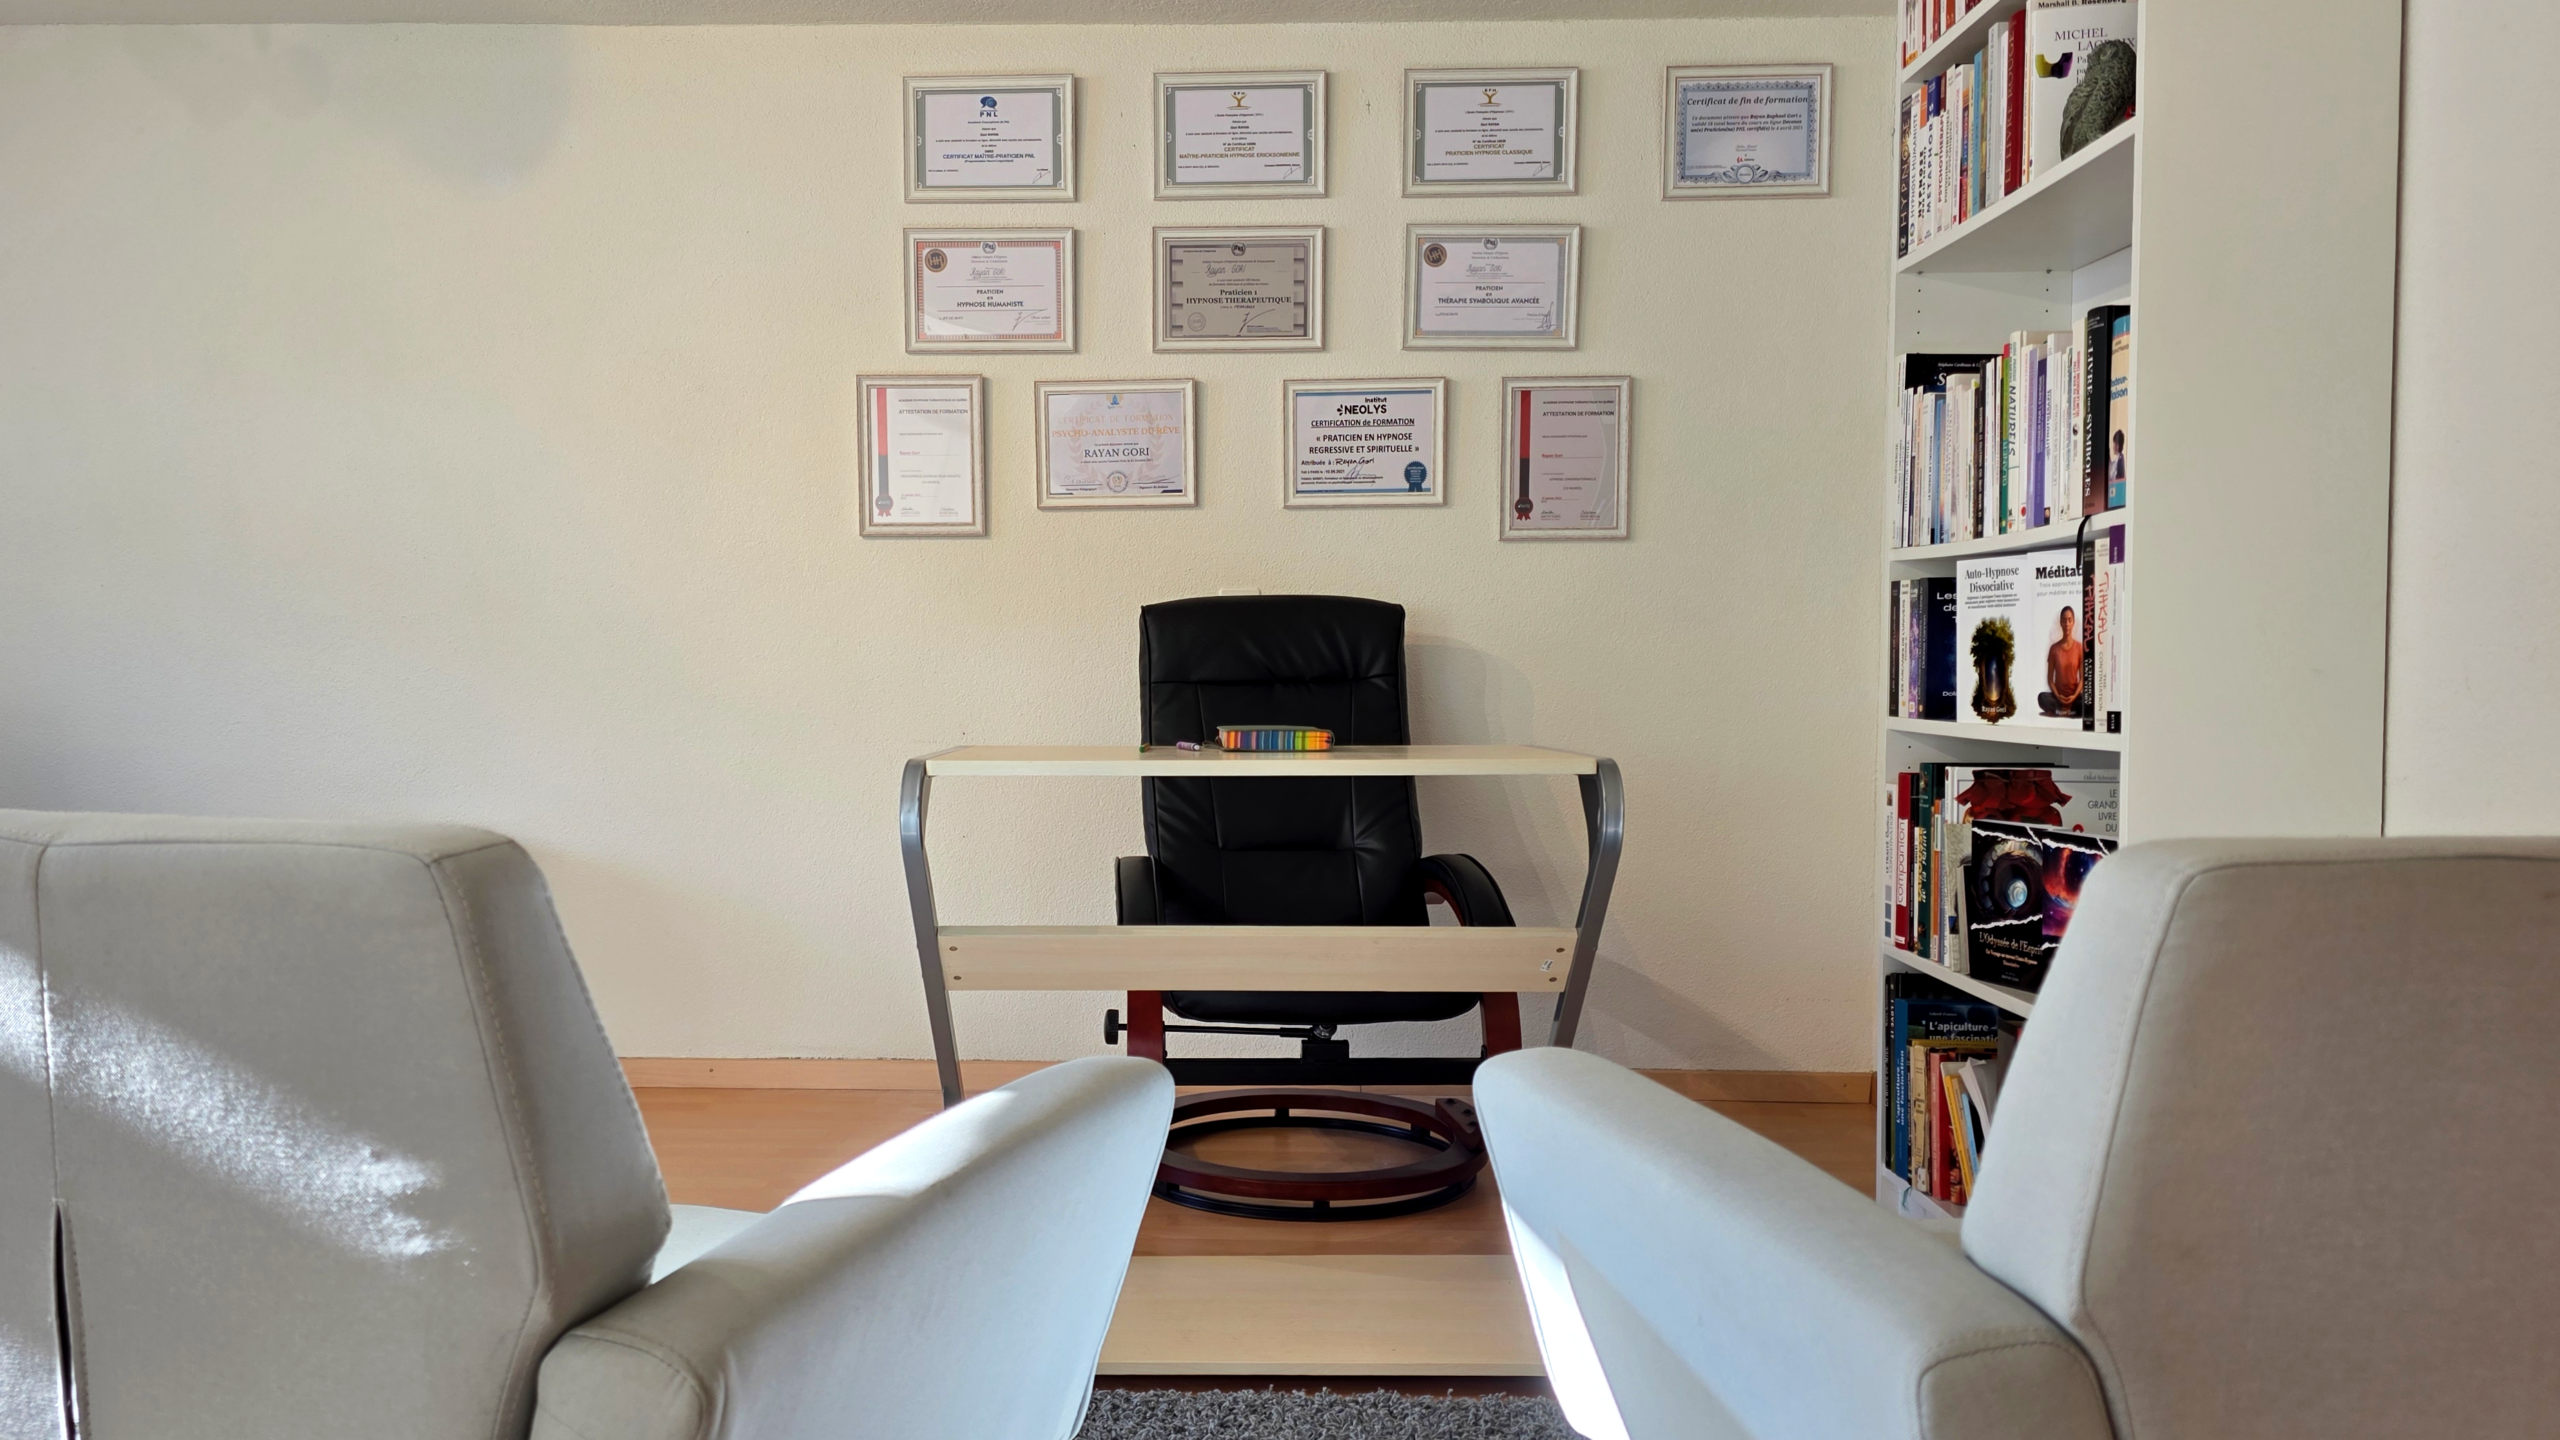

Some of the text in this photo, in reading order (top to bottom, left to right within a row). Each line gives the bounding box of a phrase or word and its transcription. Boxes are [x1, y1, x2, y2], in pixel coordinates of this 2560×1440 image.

[2038, 0, 2070, 9] Marshall
[2054, 28, 2108, 41] MICHEL
[1687, 95, 1808, 107] Certificat de fin de formation
[2005, 31, 2014, 184] LE LIVRE ROUGE
[1900, 119, 1910, 228] HYPNOSE
[1438, 296, 1468, 304] THÉRAPIE
[1511, 296, 1540, 304] AVANCÉE
[1344, 404, 1387, 415] NEOLYS
[1311, 419, 1361, 427] CERTIFICATION
[1372, 418, 1415, 426] FORMATION
[2008, 386, 2017, 456] NATURELS
[1051, 427, 1139, 438] PSYCHO-ANALYSTE
[1156, 425, 1180, 434] RÊVE
[1322, 434, 1363, 442] PRATICIEN
[1376, 432, 1413, 441] HYPNOSE
[1084, 447, 1149, 458] RAYAN GORI
[1309, 446, 1354, 454] REGRESSIVE
[1366, 445, 1413, 453] SPIRITUELLE
[2084, 414, 2092, 497] SYMBOLES
[1964, 567, 2019, 580] Auto-Hypnose
[2035, 565, 2083, 580] Méditat
[1970, 579, 2014, 593] Dissociative
[1981, 705, 2006, 714] Rayan Gori
[2109, 789, 2118, 798] LE
[2087, 800, 2118, 809] GRAND
[2098, 812, 2117, 821] LIVRE
[2105, 823, 2118, 833] DU
[1897, 821, 1907, 903] companion
[1979, 931, 2043, 957] L'Odyssée de l'Esprit
[1929, 1021, 1989, 1033] L'apiculture
